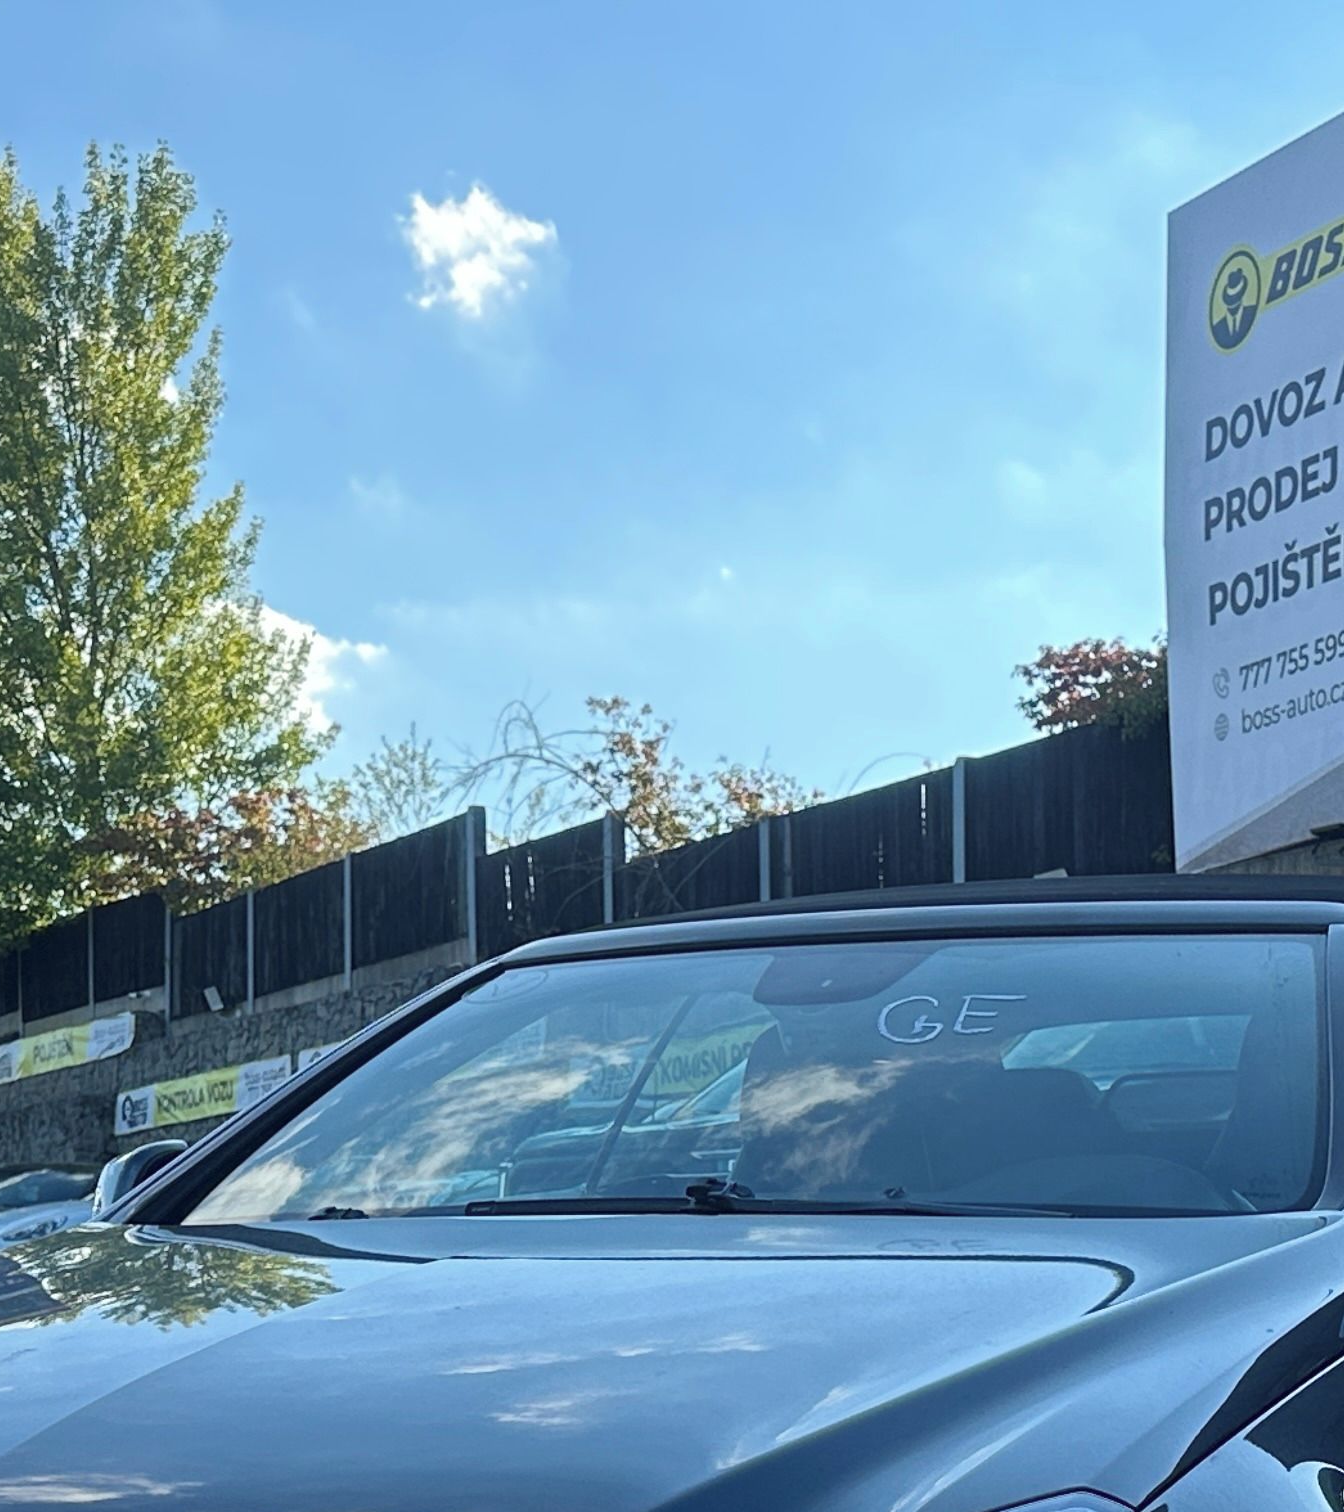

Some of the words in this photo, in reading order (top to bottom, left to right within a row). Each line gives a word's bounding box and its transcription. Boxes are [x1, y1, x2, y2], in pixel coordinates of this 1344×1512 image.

[1205, 367, 1327, 462] DOVOZ
[1204, 444, 1339, 542] PRODEJ
[1239, 656, 1273, 691] 777
[1276, 643, 1309, 679] 755
